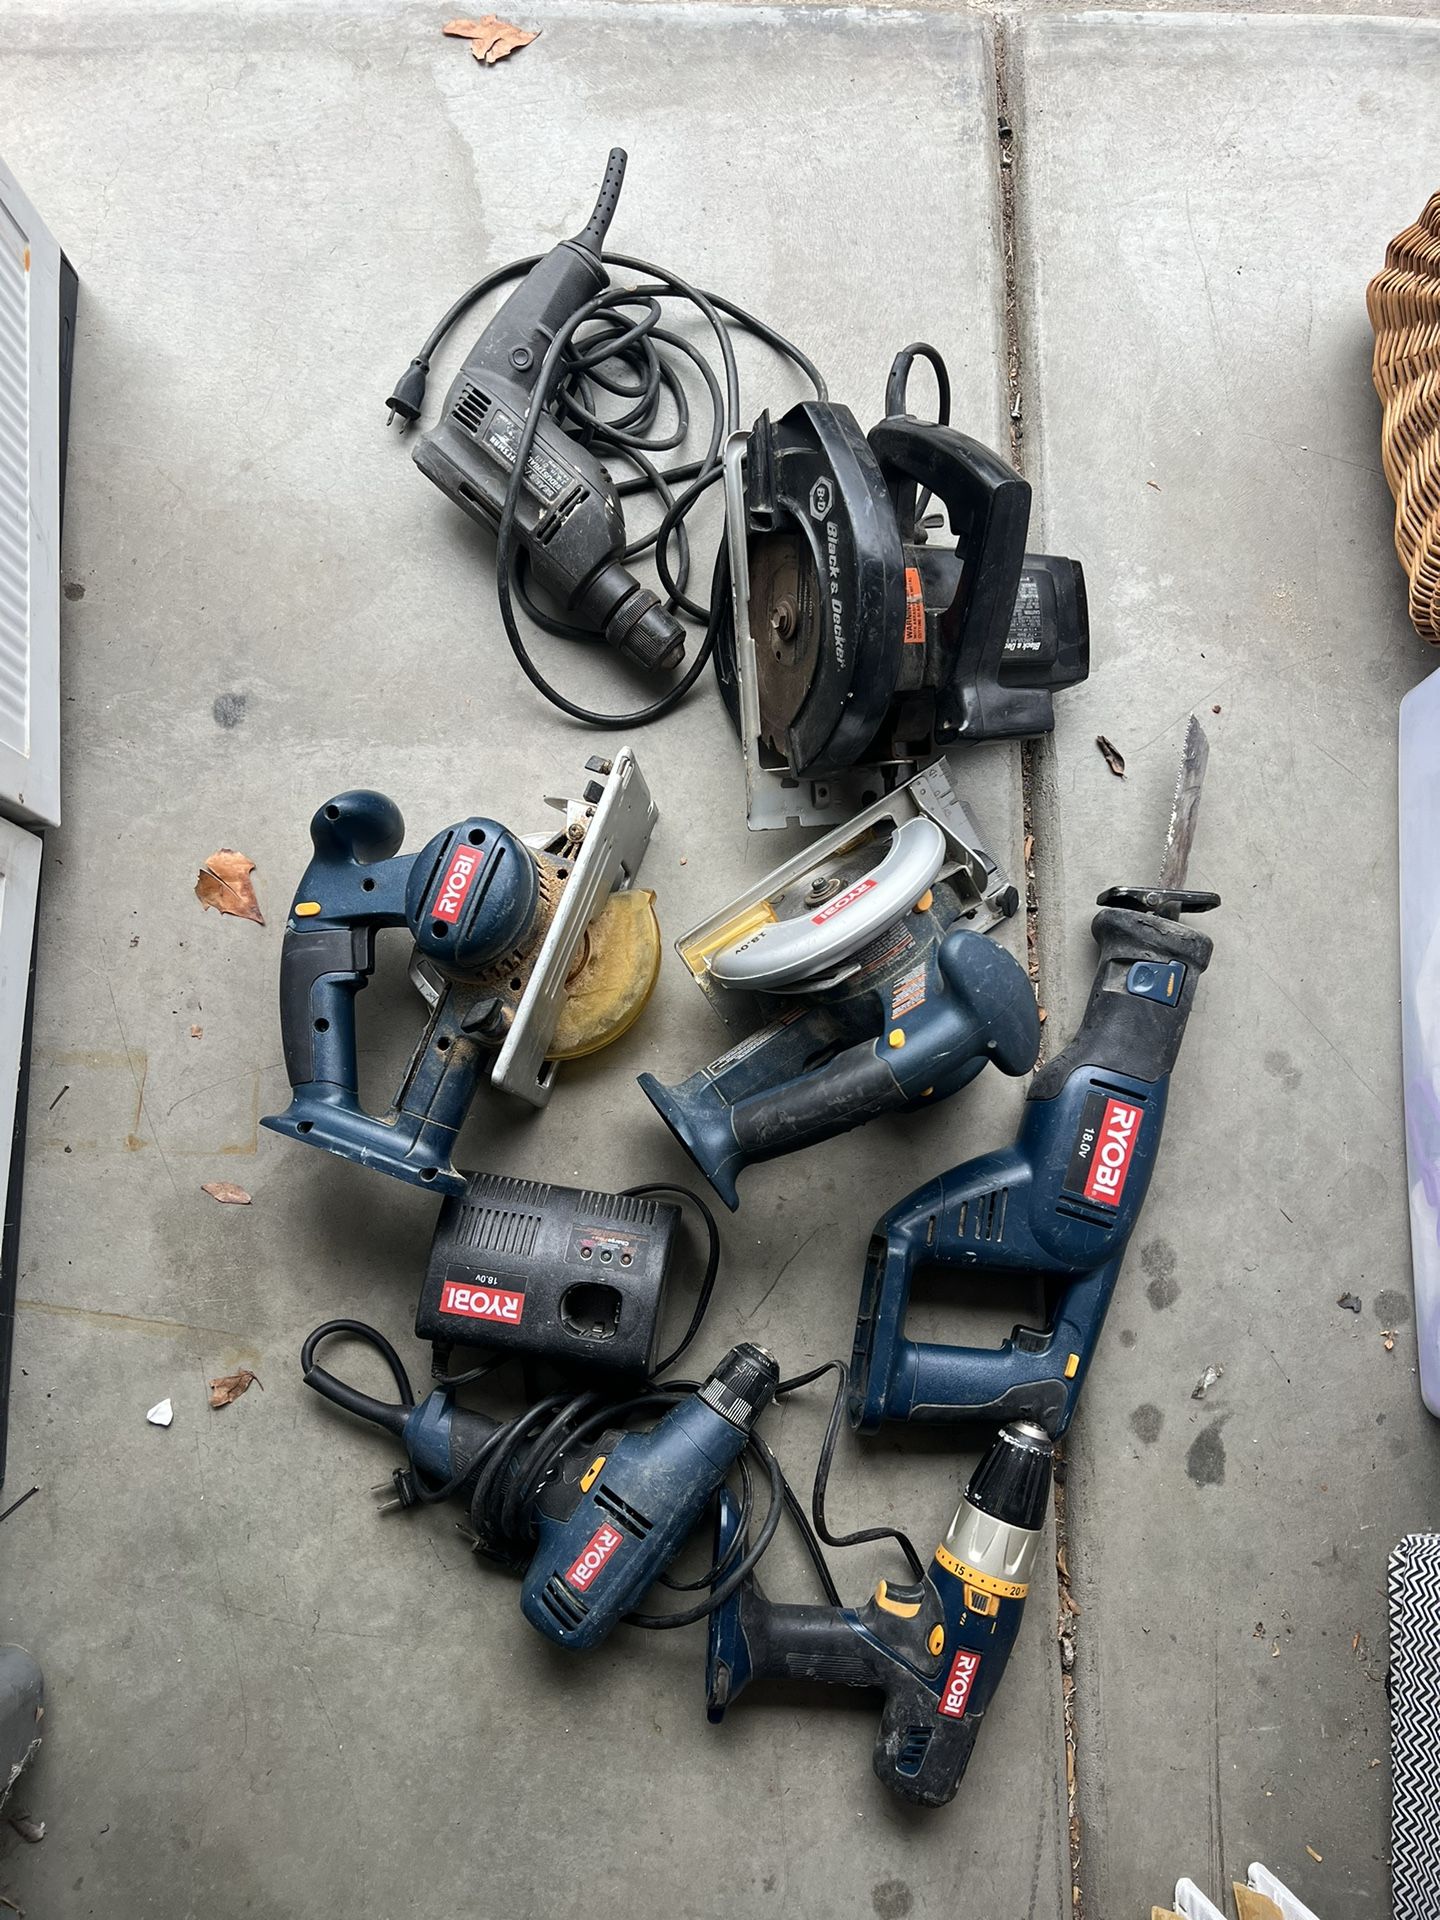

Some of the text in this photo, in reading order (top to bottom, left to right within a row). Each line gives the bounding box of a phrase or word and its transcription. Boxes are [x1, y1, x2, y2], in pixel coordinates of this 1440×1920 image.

[827, 521, 846, 668] Black & Decker
[438, 855, 475, 914] RYOBI
[820, 883, 872, 919] RYOBI
[1078, 1128, 1095, 1158] 18.0v
[1092, 1107, 1136, 1196] RYOBI
[475, 1274, 497, 1285] 18.0v
[447, 1287, 519, 1319] RYOBI
[571, 1530, 618, 1585] RYOBI
[954, 1564, 964, 1576] 15
[1010, 1587, 1021, 1596] 20
[944, 1655, 976, 1714] RYOBI
